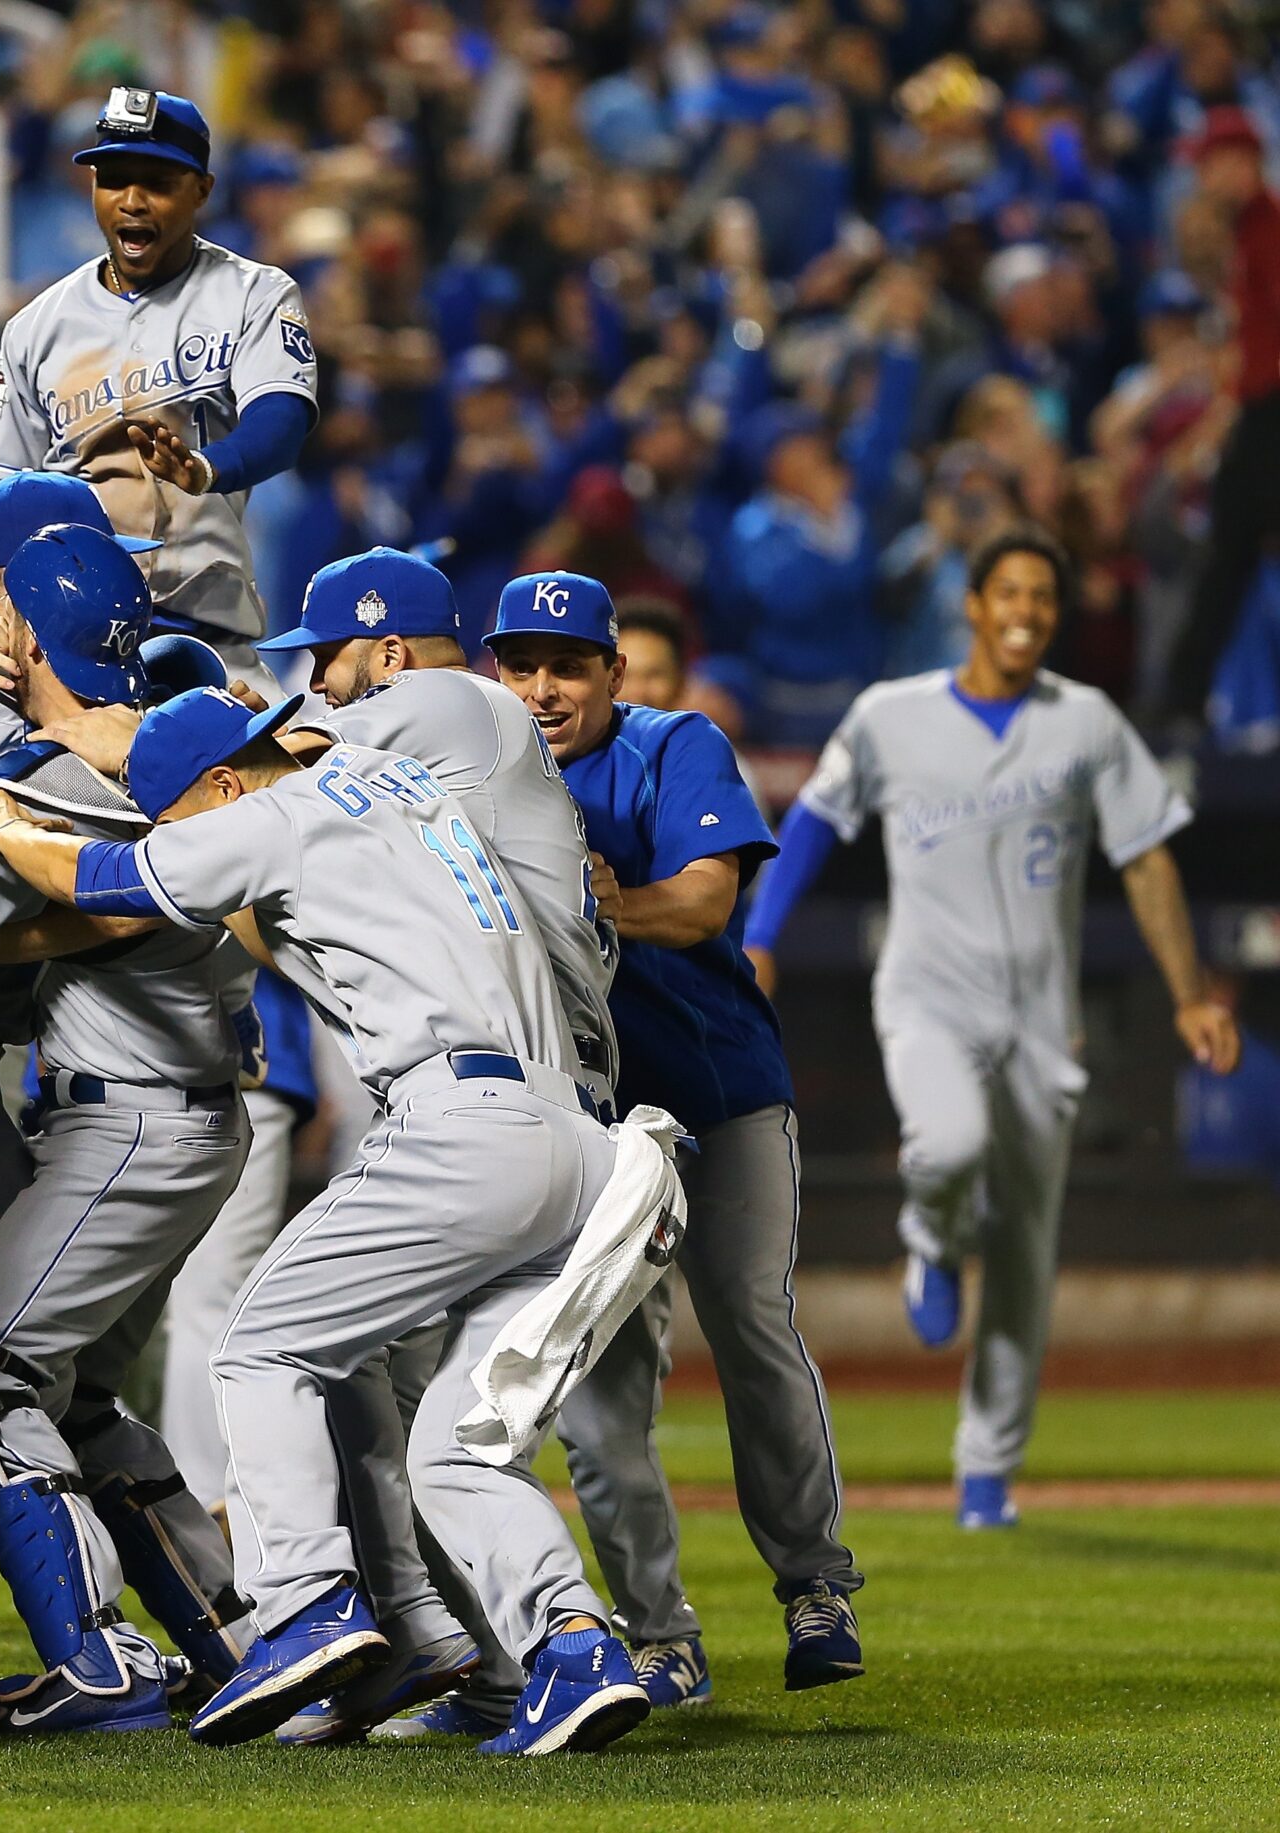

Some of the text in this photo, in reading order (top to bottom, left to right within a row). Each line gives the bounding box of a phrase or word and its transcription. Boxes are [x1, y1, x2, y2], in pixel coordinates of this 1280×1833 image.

[176, 330, 239, 388] Cit
[284, 323, 315, 361] KC
[191, 400, 210, 451] 1
[532, 581, 570, 618] KC
[101, 619, 138, 657] KC
[415, 814, 524, 935] 11
[591, 1645, 605, 1672] MVP
